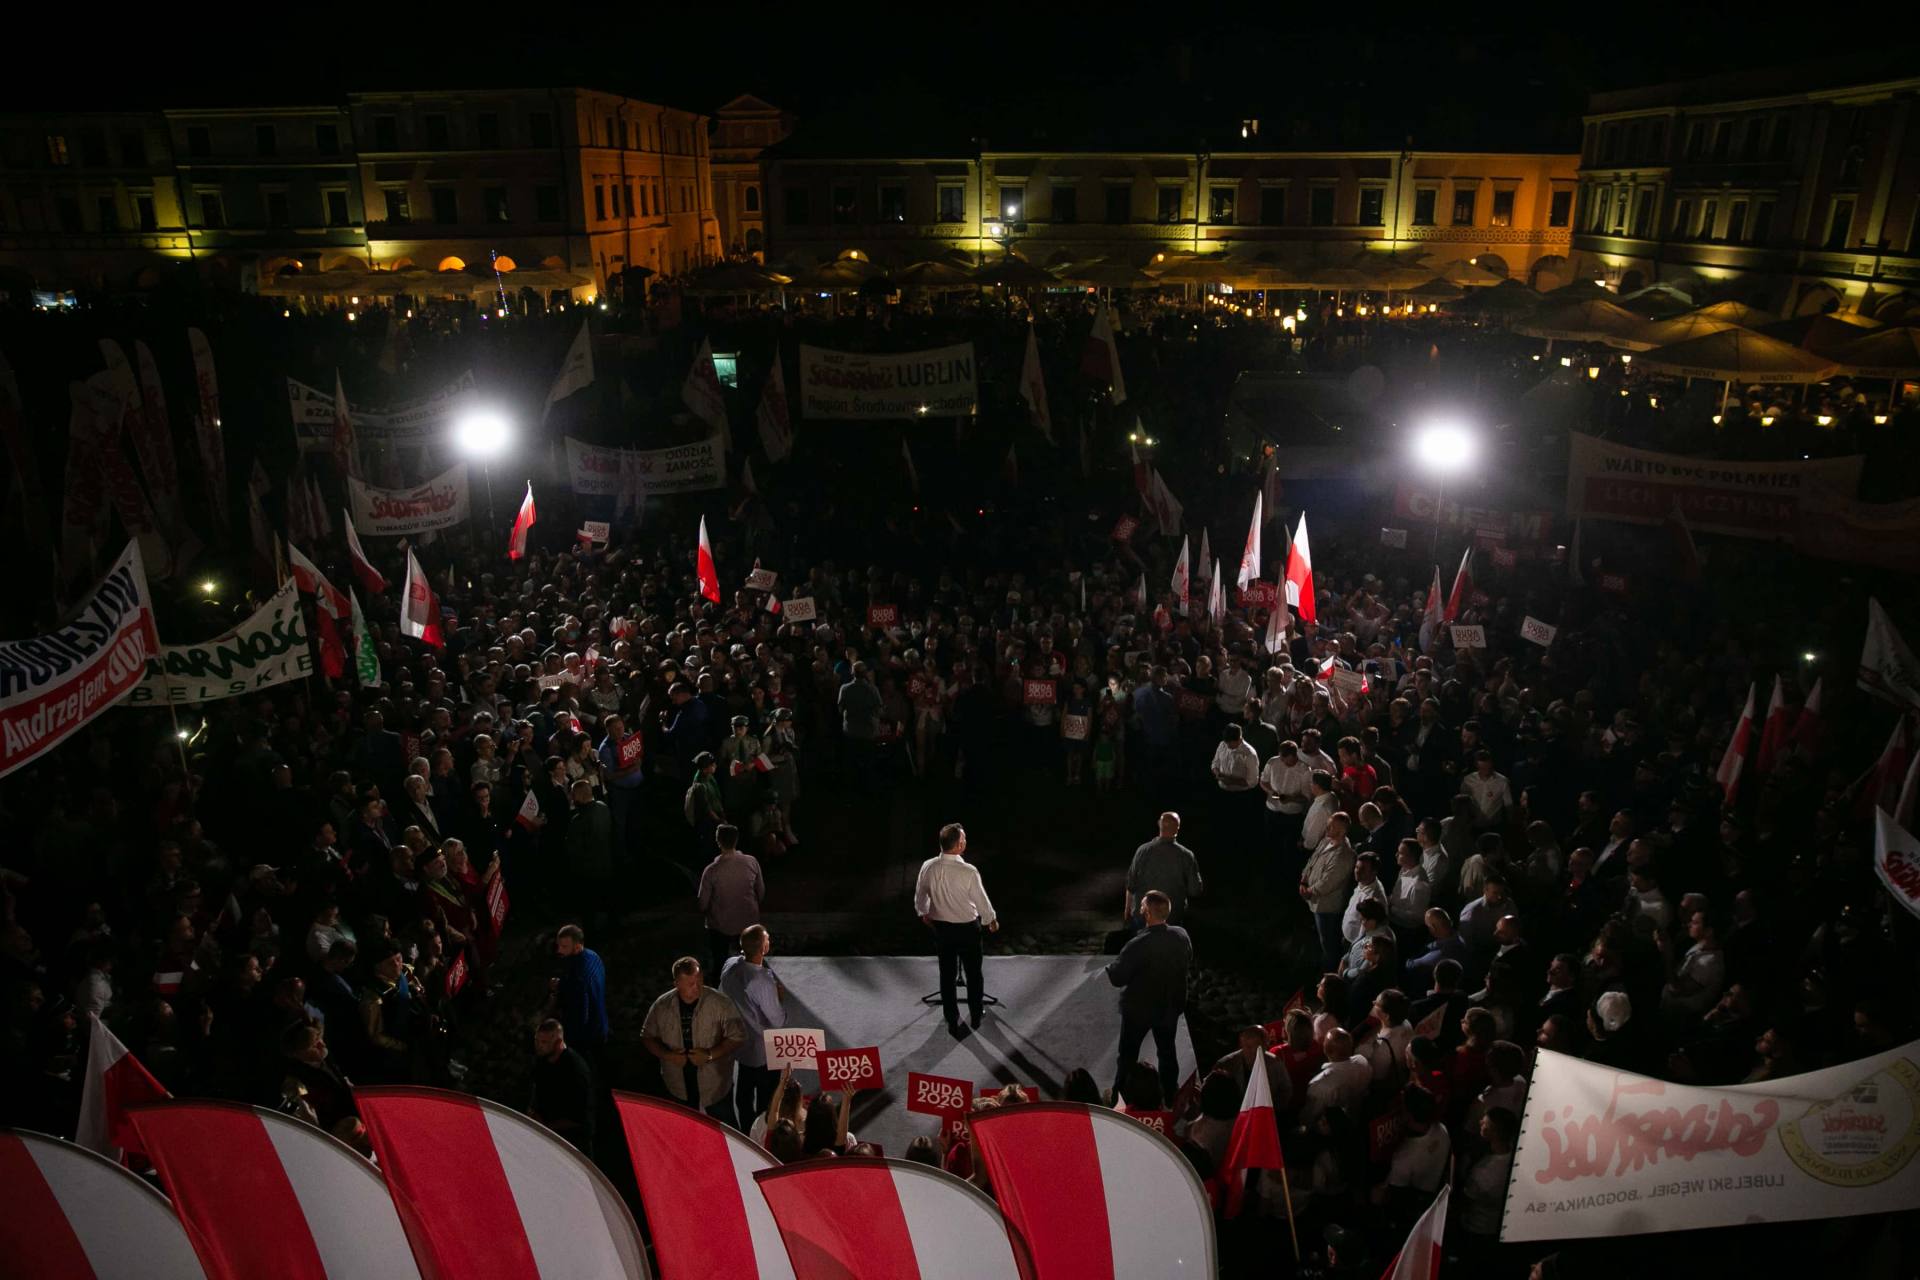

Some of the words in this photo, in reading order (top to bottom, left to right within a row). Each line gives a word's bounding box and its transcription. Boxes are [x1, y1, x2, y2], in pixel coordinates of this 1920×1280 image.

[897, 358, 972, 387] LUBLIN
[1605, 456, 1666, 475] WARTO
[774, 1035, 818, 1048] DUDA
[775, 1047, 819, 1058] 2020
[826, 1054, 872, 1070] DUDA
[828, 1066, 874, 1081] 2020
[918, 1080, 964, 1098] DUDA
[917, 1091, 965, 1109] 2020
